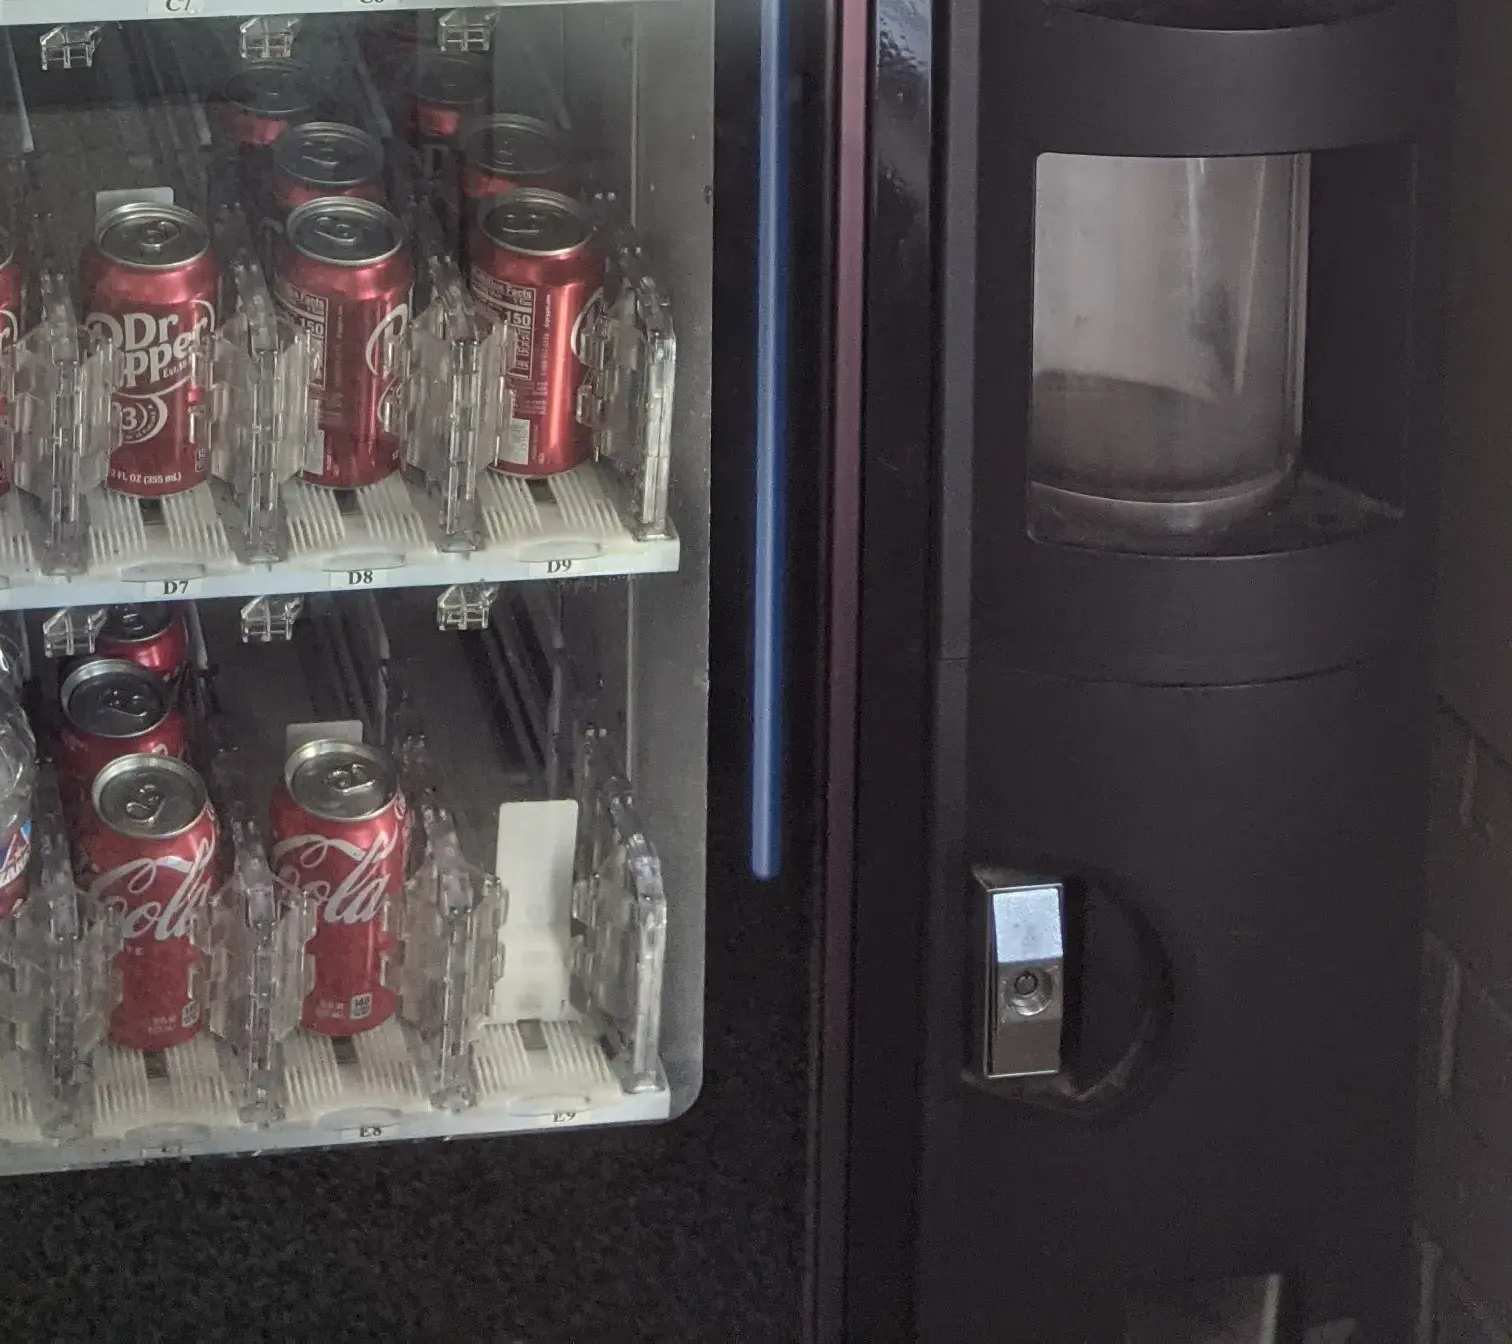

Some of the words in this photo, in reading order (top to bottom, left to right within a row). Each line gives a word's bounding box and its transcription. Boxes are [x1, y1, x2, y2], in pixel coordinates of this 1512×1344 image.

[124, 312, 178, 350] Dr
[546, 559, 573, 574] D9
[348, 569, 374, 585] D8
[162, 579, 190, 597] D7
